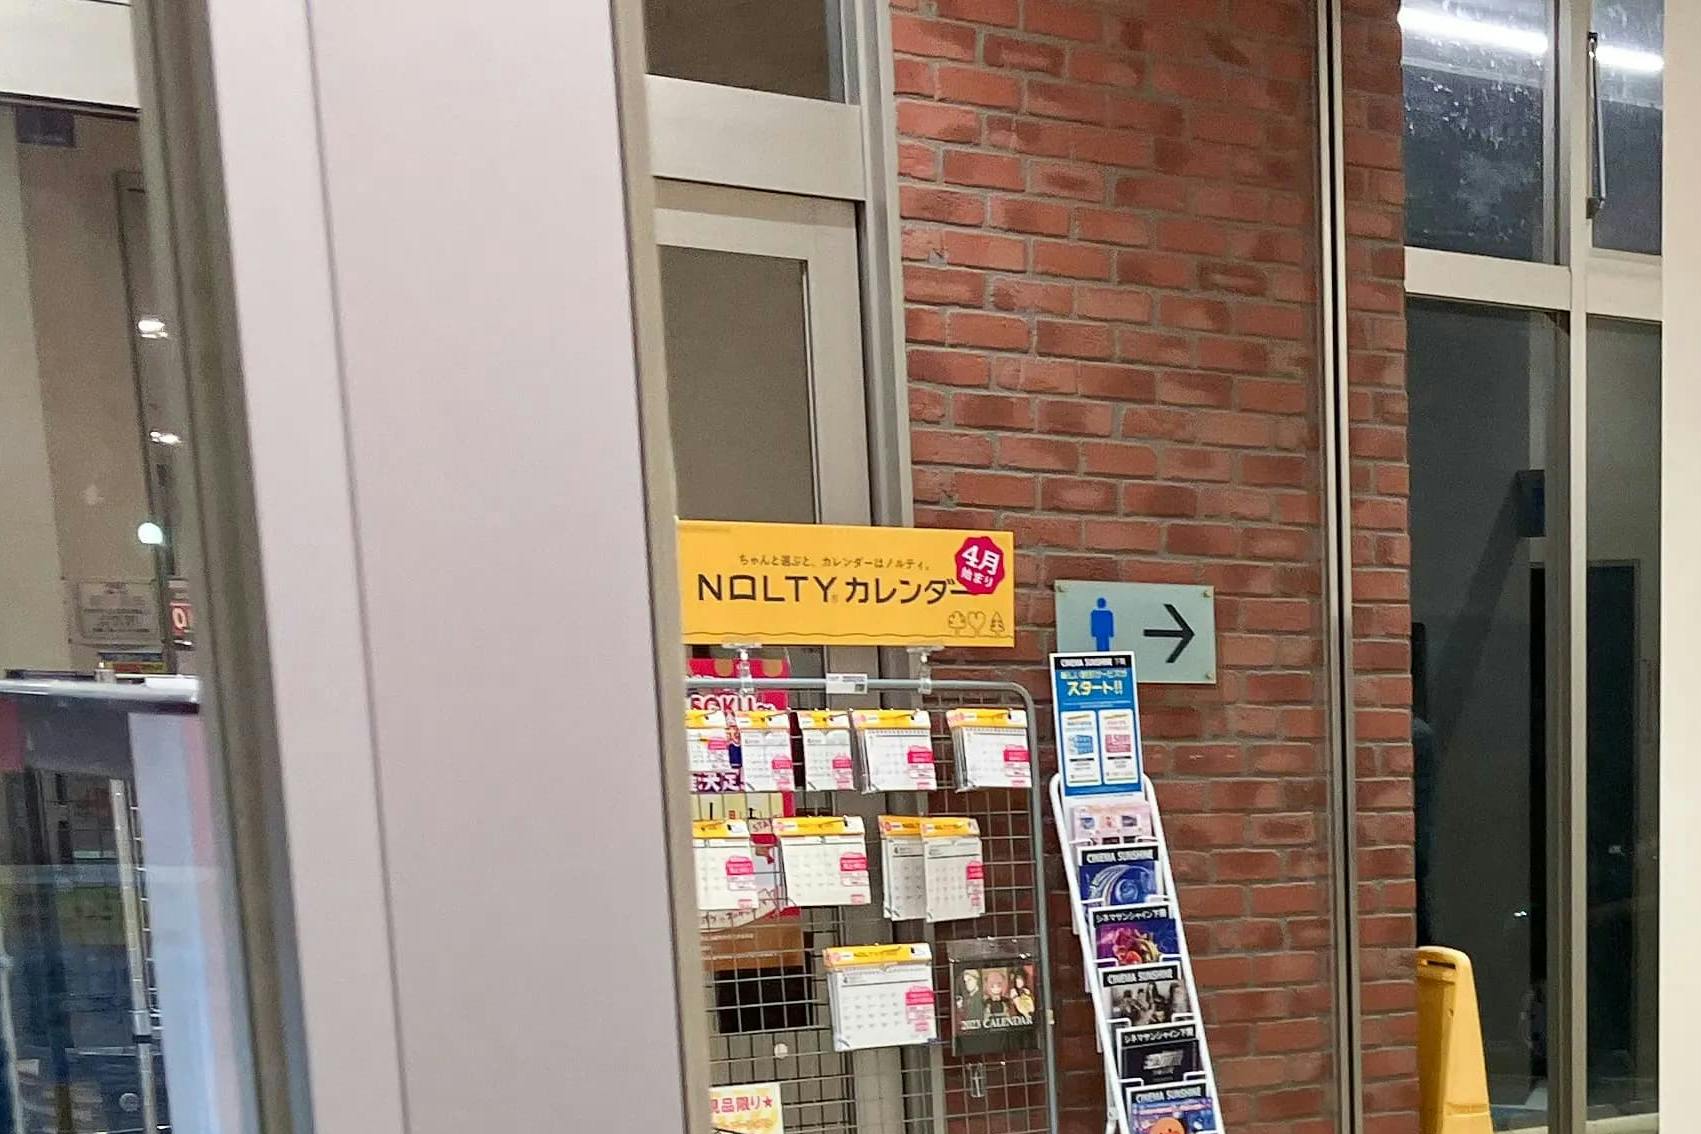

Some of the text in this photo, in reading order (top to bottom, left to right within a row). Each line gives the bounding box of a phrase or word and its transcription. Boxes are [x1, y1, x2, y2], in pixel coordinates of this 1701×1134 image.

[962, 545, 1000, 574] 4月
[960, 568, 994, 588] 始まり
